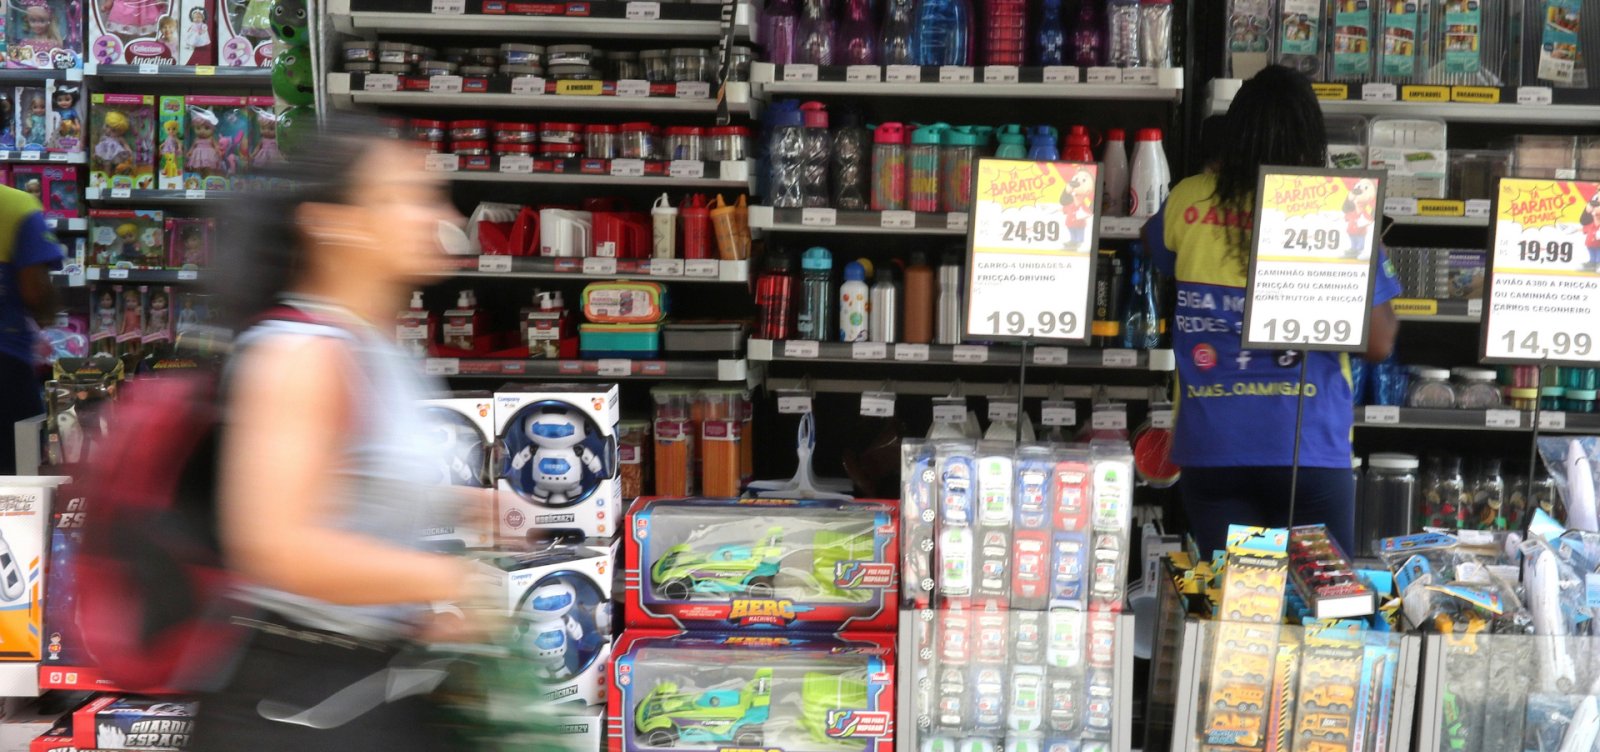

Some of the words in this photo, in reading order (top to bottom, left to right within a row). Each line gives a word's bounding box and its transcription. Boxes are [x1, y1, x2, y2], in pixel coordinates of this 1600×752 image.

[1511, 195, 1564, 216] BARATO
[1002, 221, 1060, 244] 24,99
[1283, 228, 1341, 251] 24,99
[1517, 240, 1574, 264] 19,99
[1307, 271, 1359, 279] BOMBEIROS
[1492, 303, 1530, 312] CARROS
[987, 310, 1077, 336] 19,99
[1263, 318, 1352, 344] 19,99
[1502, 329, 1593, 360] 14,99
